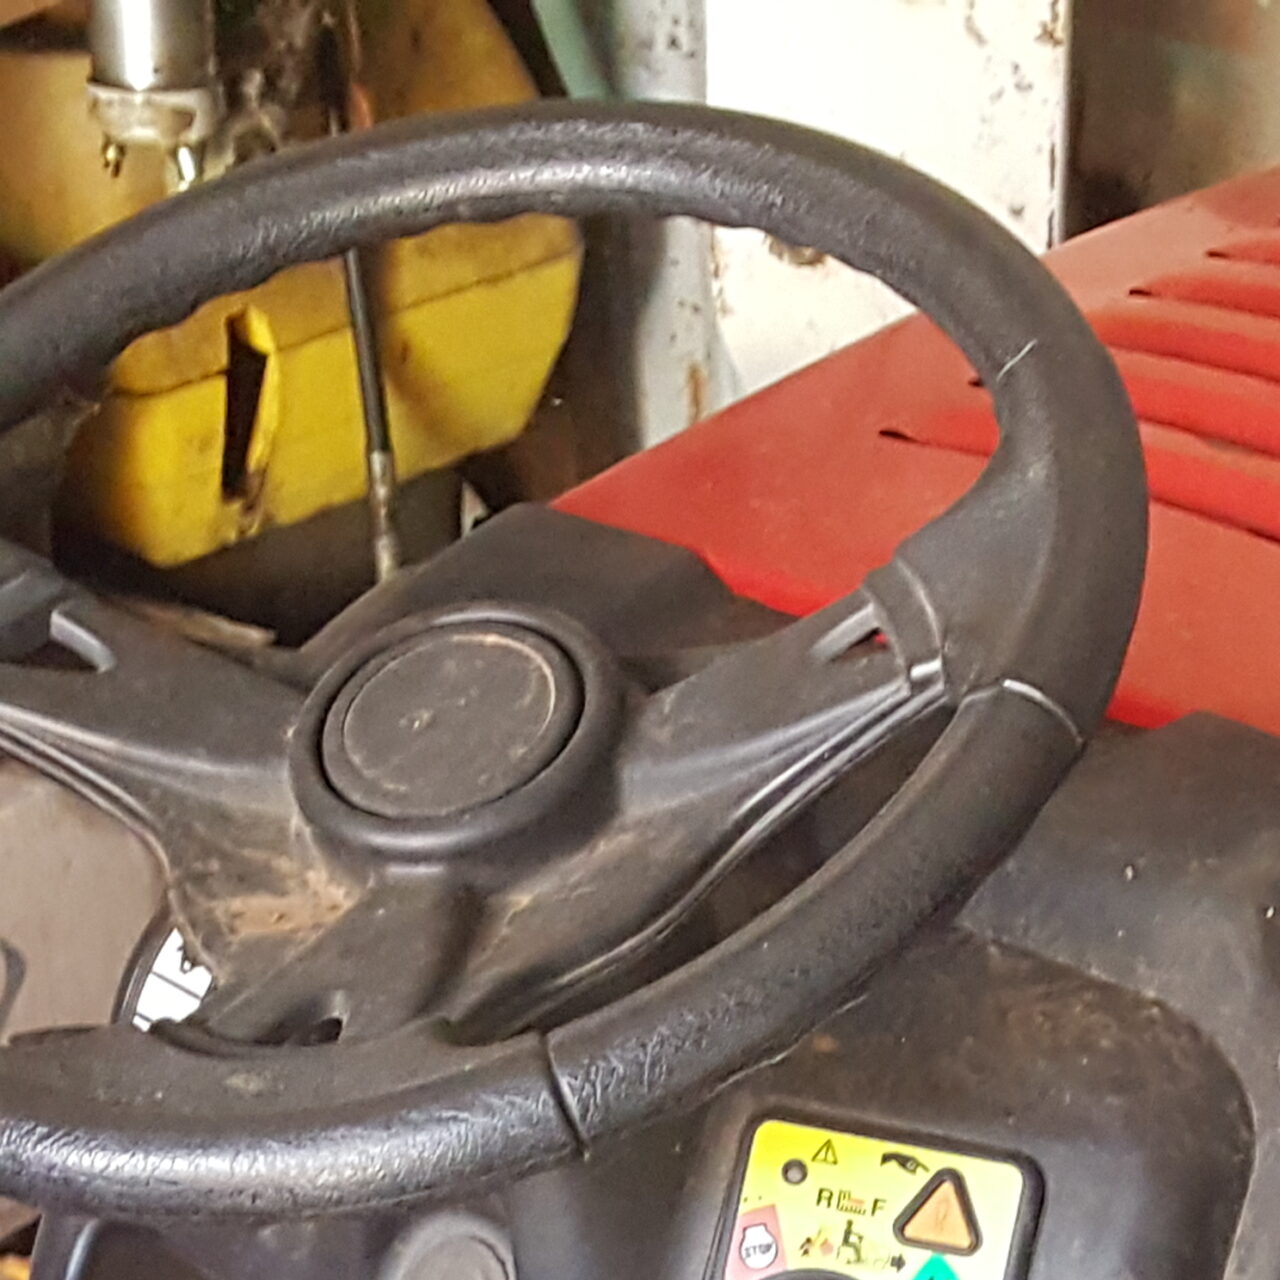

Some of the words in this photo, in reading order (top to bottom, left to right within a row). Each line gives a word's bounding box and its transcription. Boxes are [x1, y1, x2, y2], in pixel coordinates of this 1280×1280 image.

[816, 1187, 834, 1208] R
[871, 1197, 887, 1217] F
[743, 1241, 774, 1259] STOP
